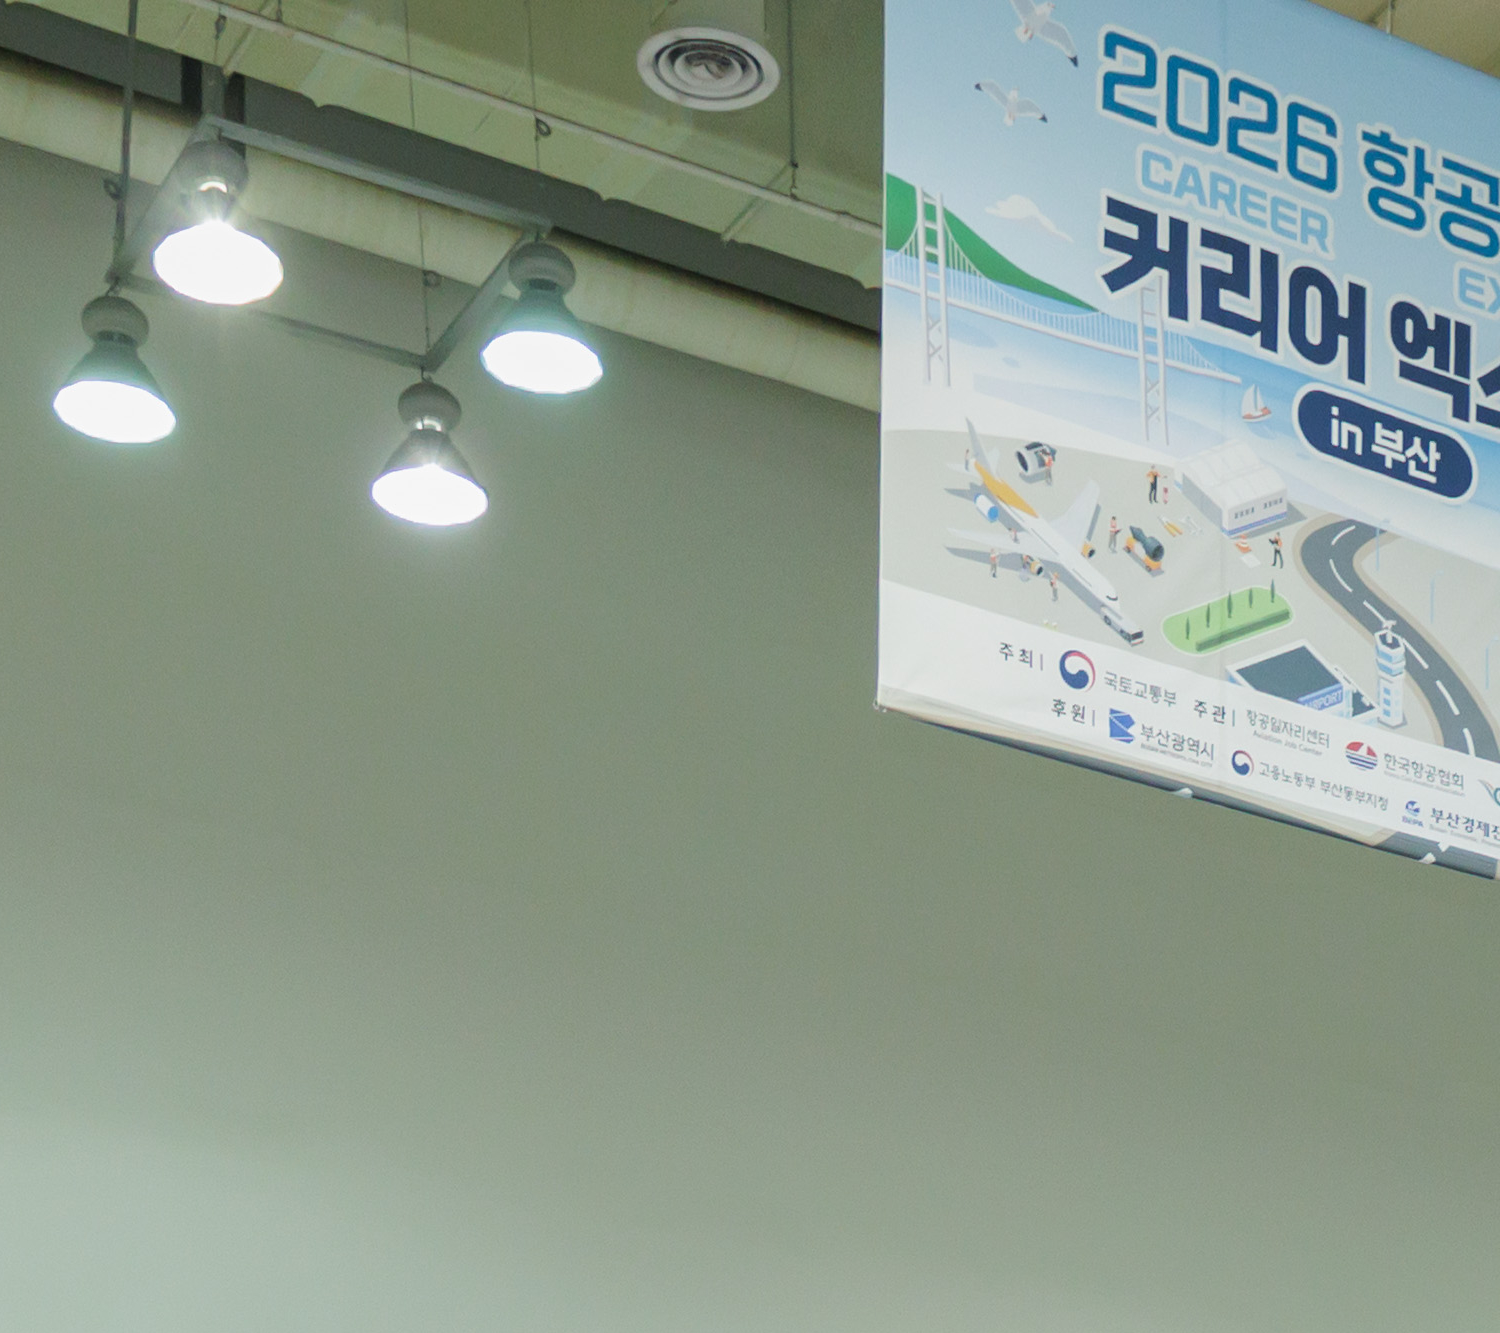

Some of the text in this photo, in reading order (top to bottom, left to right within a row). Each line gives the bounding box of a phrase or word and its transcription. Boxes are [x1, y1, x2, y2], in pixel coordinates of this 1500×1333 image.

[1102, 31, 1338, 193] 2026
[1141, 150, 1330, 254] CAREER
[1101, 196, 1367, 386] 커리어
[1330, 405, 1441, 484] in 부산
[1103, 671, 1177, 707] 국토교통부
[1140, 723, 1215, 761] 부산광역시
[1383, 751, 1465, 790] 한국항공협회
[1258, 761, 1316, 790] 고용노동부
[1320, 779, 1390, 812] 부산동부지청
